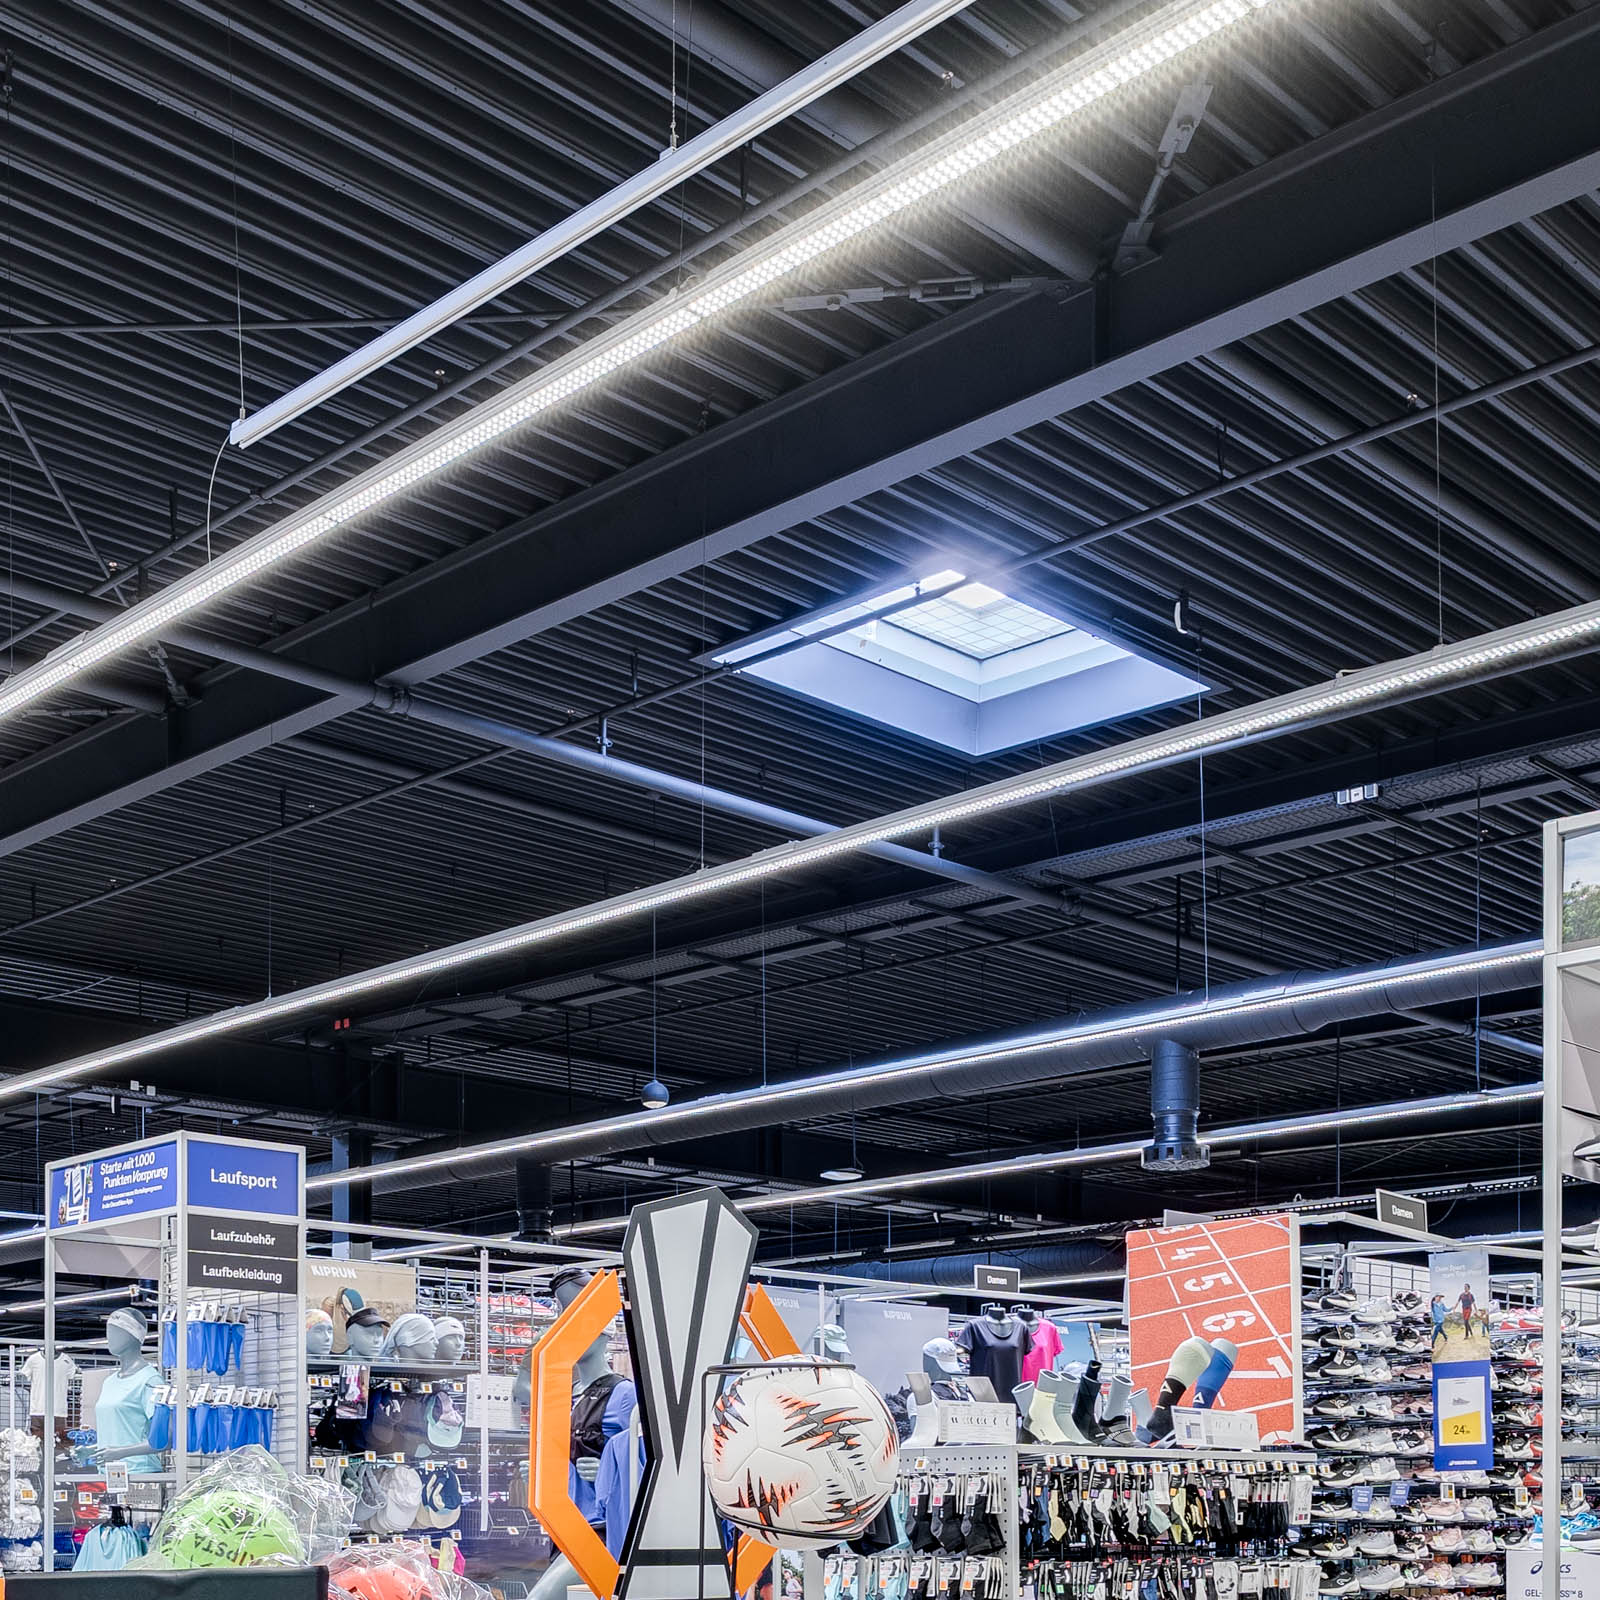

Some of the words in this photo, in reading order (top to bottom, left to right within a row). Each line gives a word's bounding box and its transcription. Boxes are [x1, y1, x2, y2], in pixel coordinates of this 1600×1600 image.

[100, 1161, 122, 1175] Starte
[104, 1172, 133, 1189] Punkten
[132, 1167, 168, 1183] Vorsprung
[210, 1168, 278, 1189] Laufsport
[1391, 1204, 1414, 1220] Damen
[210, 1229, 276, 1245] Laufzubehör
[1171, 1245, 1211, 1261] 4
[202, 1265, 283, 1284] Laufbekleidung
[311, 1265, 357, 1279] KIPRUN
[1184, 1271, 1232, 1292] 5
[1202, 1310, 1257, 1333] 6
[1453, 1424, 1464, 1435] 24
[194, 1533, 254, 1566] IPSTA
